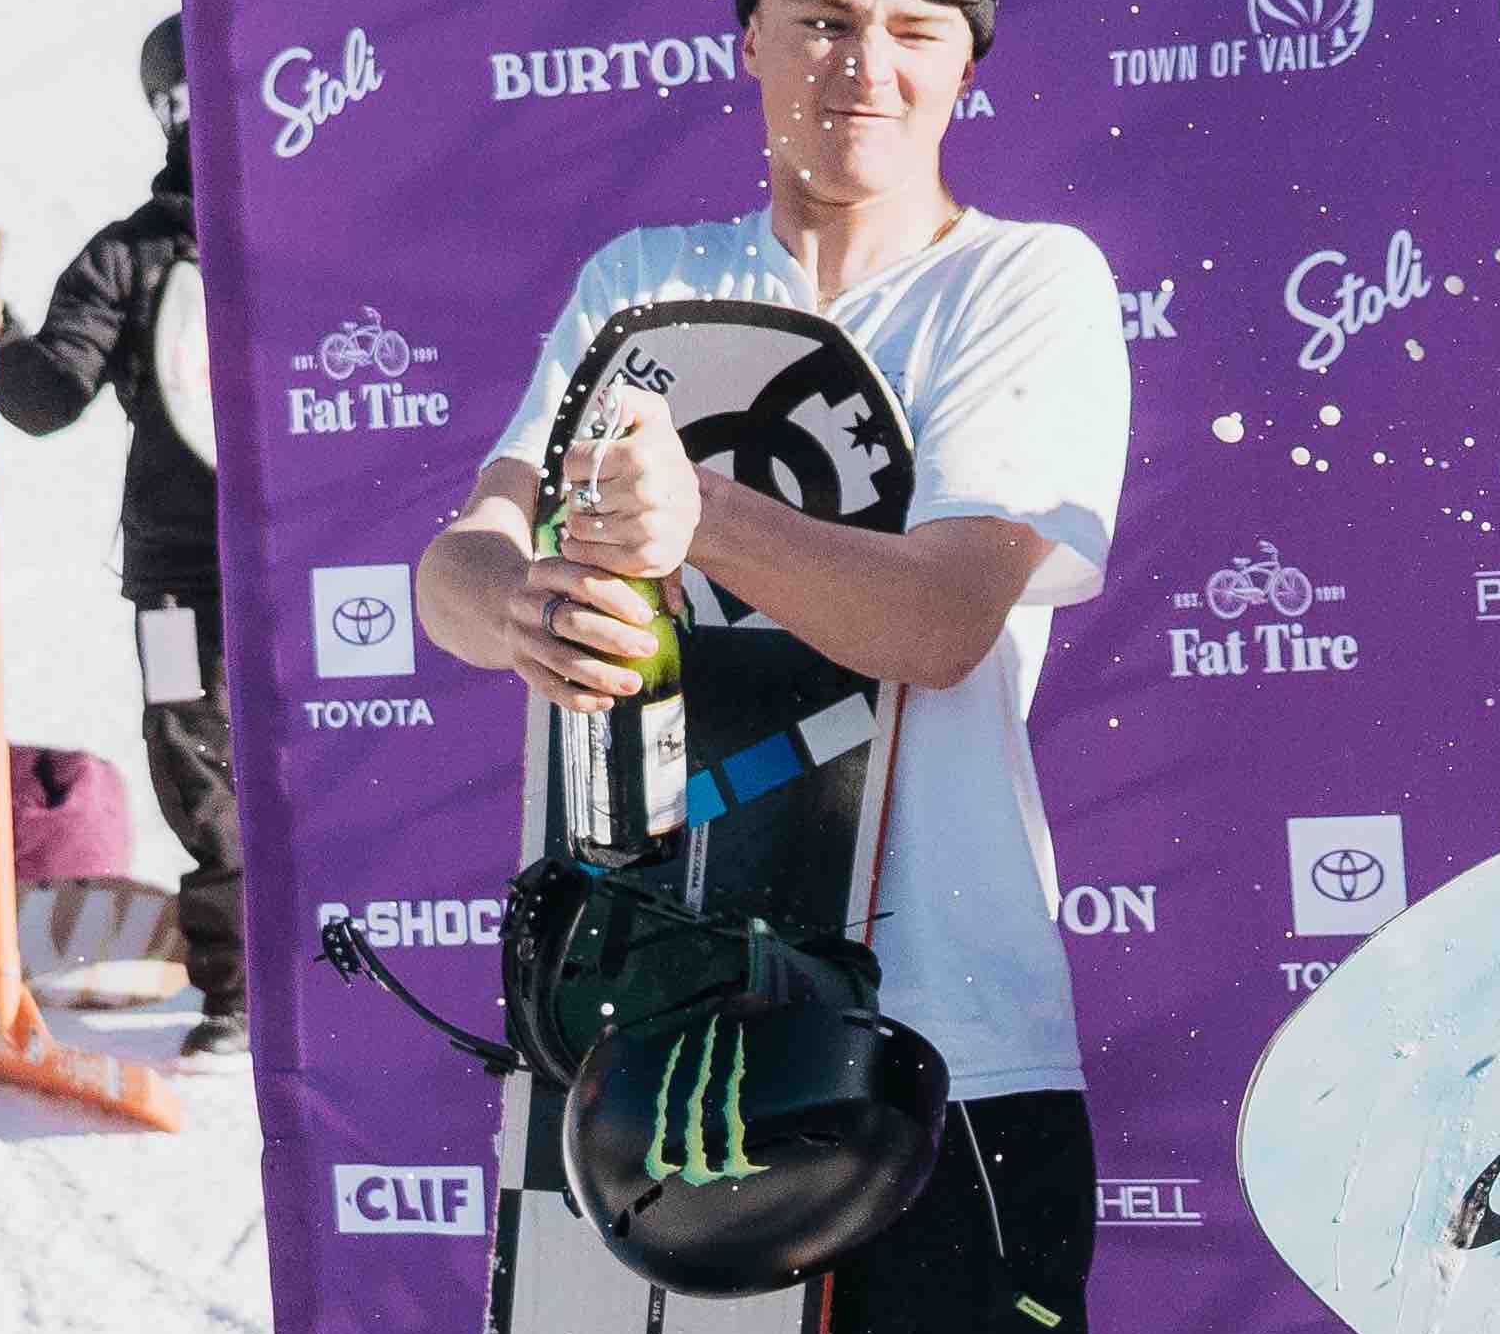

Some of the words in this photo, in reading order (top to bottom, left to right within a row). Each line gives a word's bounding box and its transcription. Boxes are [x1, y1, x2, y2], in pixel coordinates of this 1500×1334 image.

[490, 33, 736, 101] BURTON
[1108, 45, 1197, 87] TOWN
[1210, 40, 1248, 78] OF
[1258, 31, 1327, 70] VAIL
[261, 27, 383, 158] Stoli
[1284, 229, 1432, 375] Stoli
[287, 388, 357, 435] Fat
[361, 382, 449, 429] Tire
[1168, 628, 1249, 677] Fat
[1254, 622, 1358, 673] Tire
[303, 698, 434, 729] TOYOTA
[355, 1176, 469, 1223] CLIF
